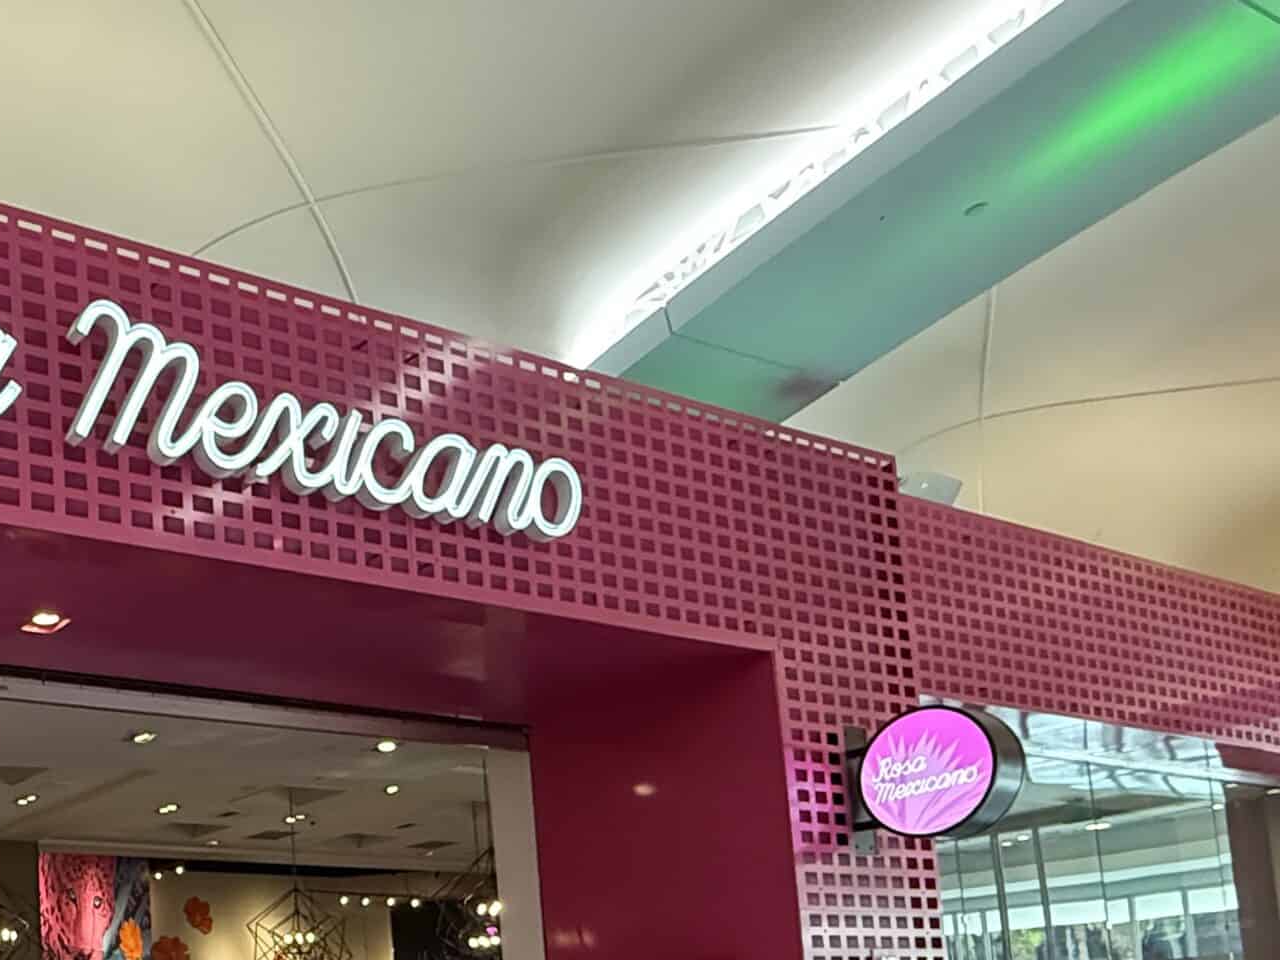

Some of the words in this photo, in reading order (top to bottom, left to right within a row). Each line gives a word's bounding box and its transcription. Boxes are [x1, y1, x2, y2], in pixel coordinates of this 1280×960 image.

[65, 299, 582, 543] Mexicano
[872, 755, 928, 783] Rosa
[874, 765, 978, 805] Mexicano
